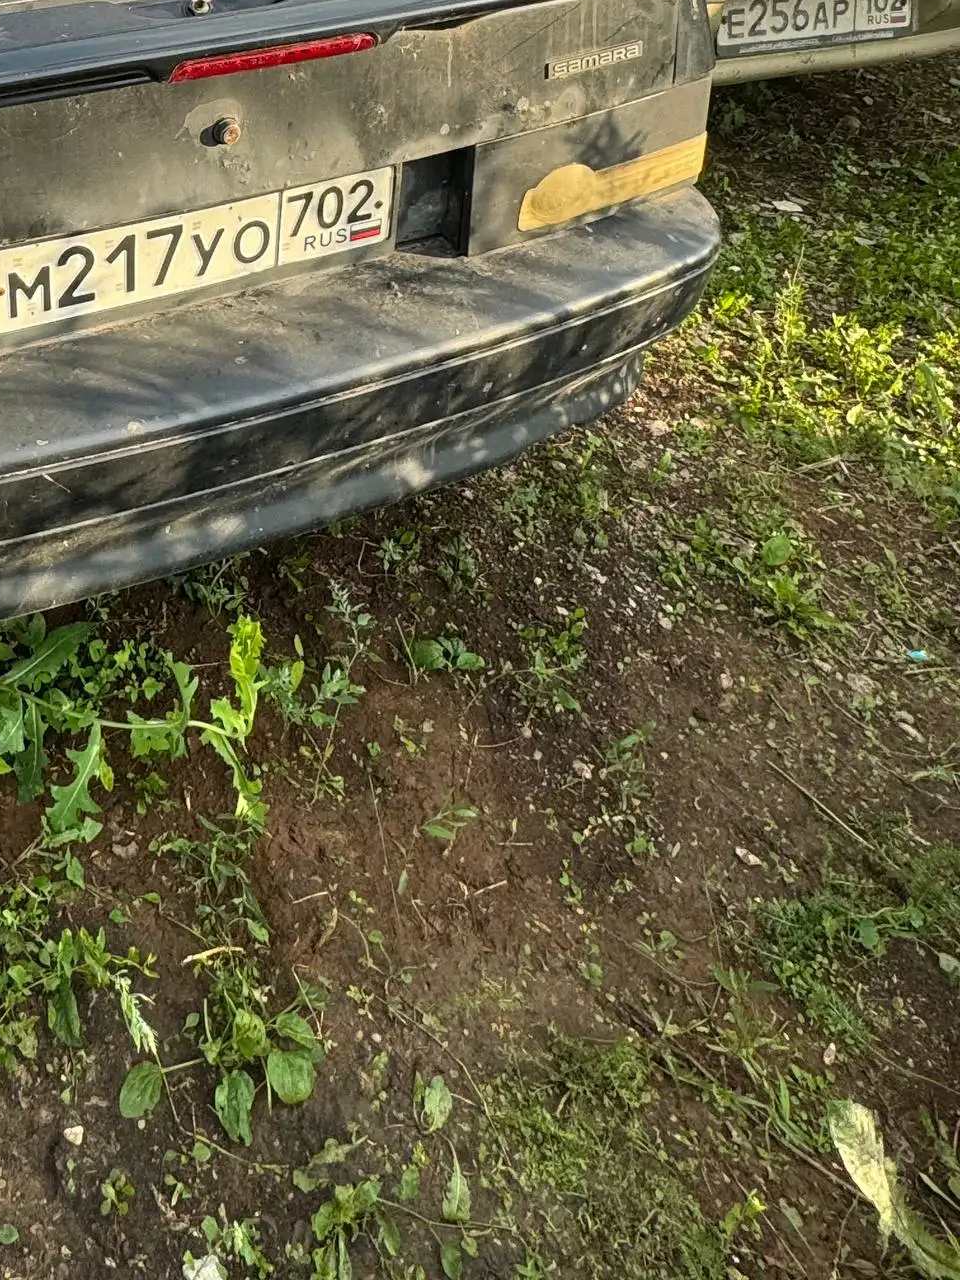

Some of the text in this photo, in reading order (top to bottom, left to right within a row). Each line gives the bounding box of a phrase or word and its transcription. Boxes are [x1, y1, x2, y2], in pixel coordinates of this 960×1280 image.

[867, 14, 889, 25] RUS
[287, 178, 376, 238] 702
[303, 227, 348, 252] RUS
